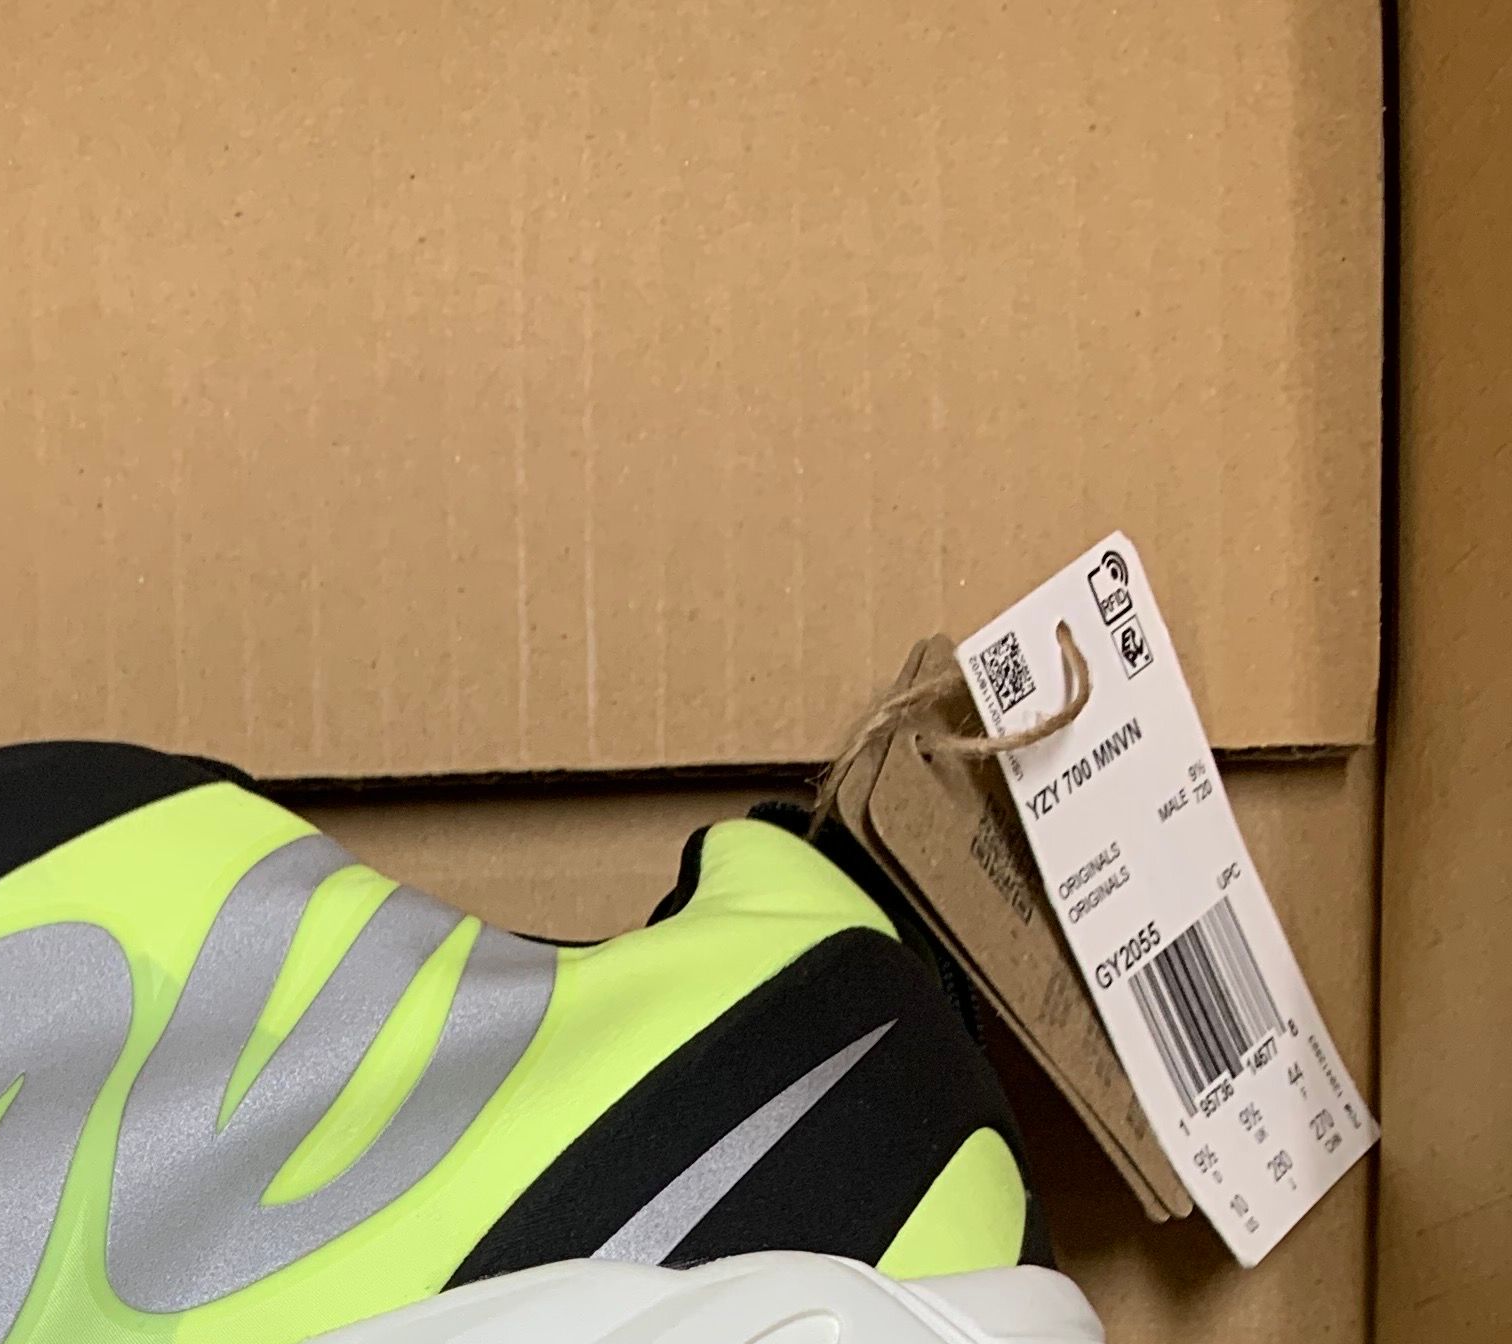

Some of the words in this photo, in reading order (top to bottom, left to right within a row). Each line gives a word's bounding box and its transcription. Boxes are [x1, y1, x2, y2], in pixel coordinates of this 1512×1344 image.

[1100, 587, 1126, 614] RFID
[1025, 779, 1060, 821] YZY
[1062, 758, 1092, 795] 700
[1092, 717, 1142, 771] MNVN
[1158, 787, 1189, 823] MALE
[1192, 779, 1213, 804] 720
[1059, 841, 1121, 900] ORIGINALS
[1068, 865, 1131, 924] ORIGINALS
[1217, 862, 1242, 890] UPC
[1095, 920, 1161, 990] GY2055
[1309, 1108, 1334, 1141] 270
